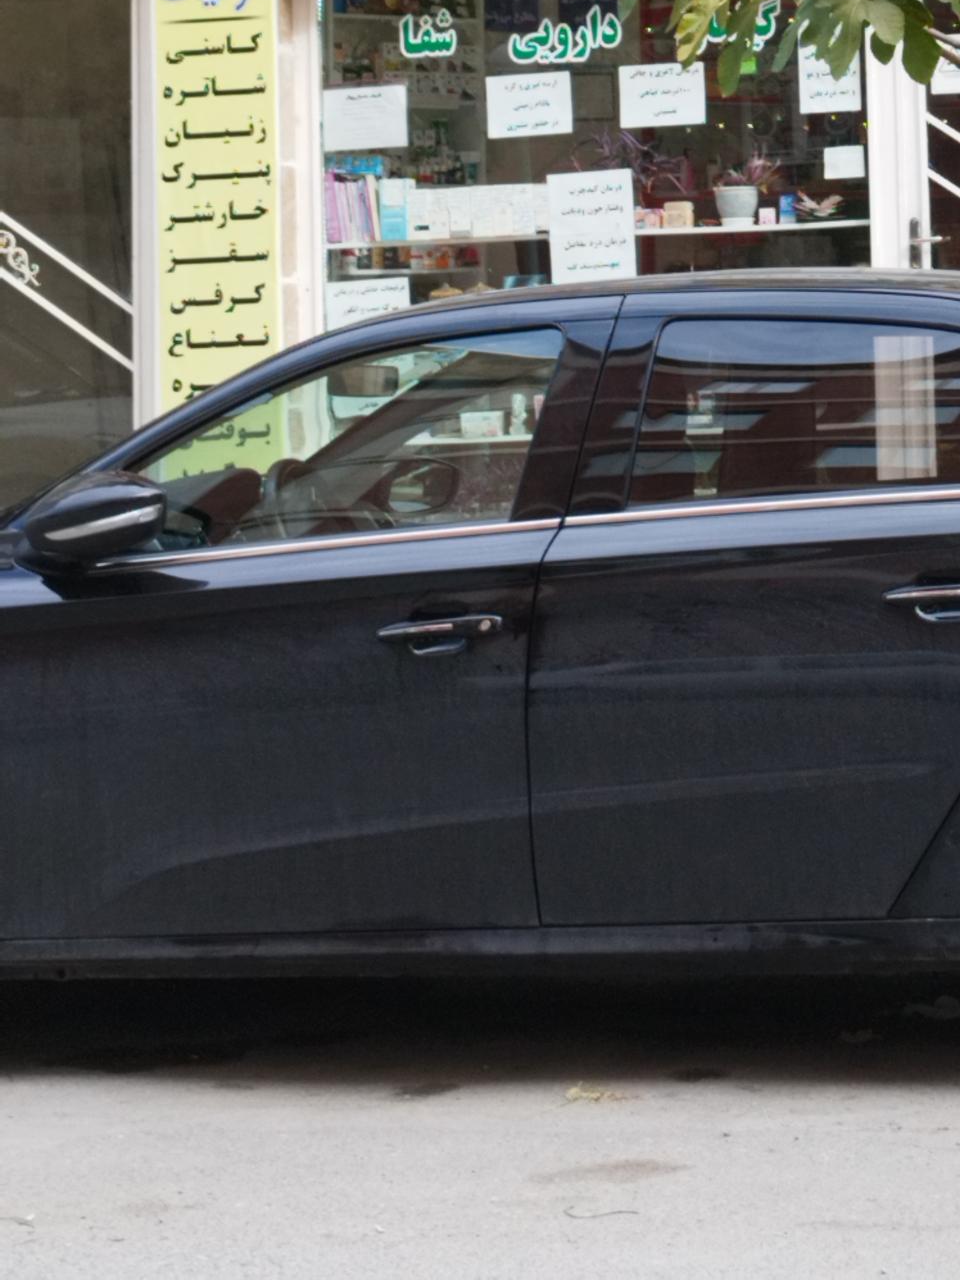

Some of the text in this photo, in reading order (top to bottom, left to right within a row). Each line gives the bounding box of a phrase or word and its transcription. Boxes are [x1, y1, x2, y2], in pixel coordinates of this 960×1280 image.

[165, 32, 262, 64] کاسنی
[400, 5, 622, 63] دارویی شفا
[165, 116, 267, 148] زنیان
[161, 160, 271, 189] پنیرک
[165, 199, 268, 231] خارشتر
[166, 242, 270, 273] سقز
[169, 282, 266, 315] کرفس
[168, 325, 270, 357] نعناع
